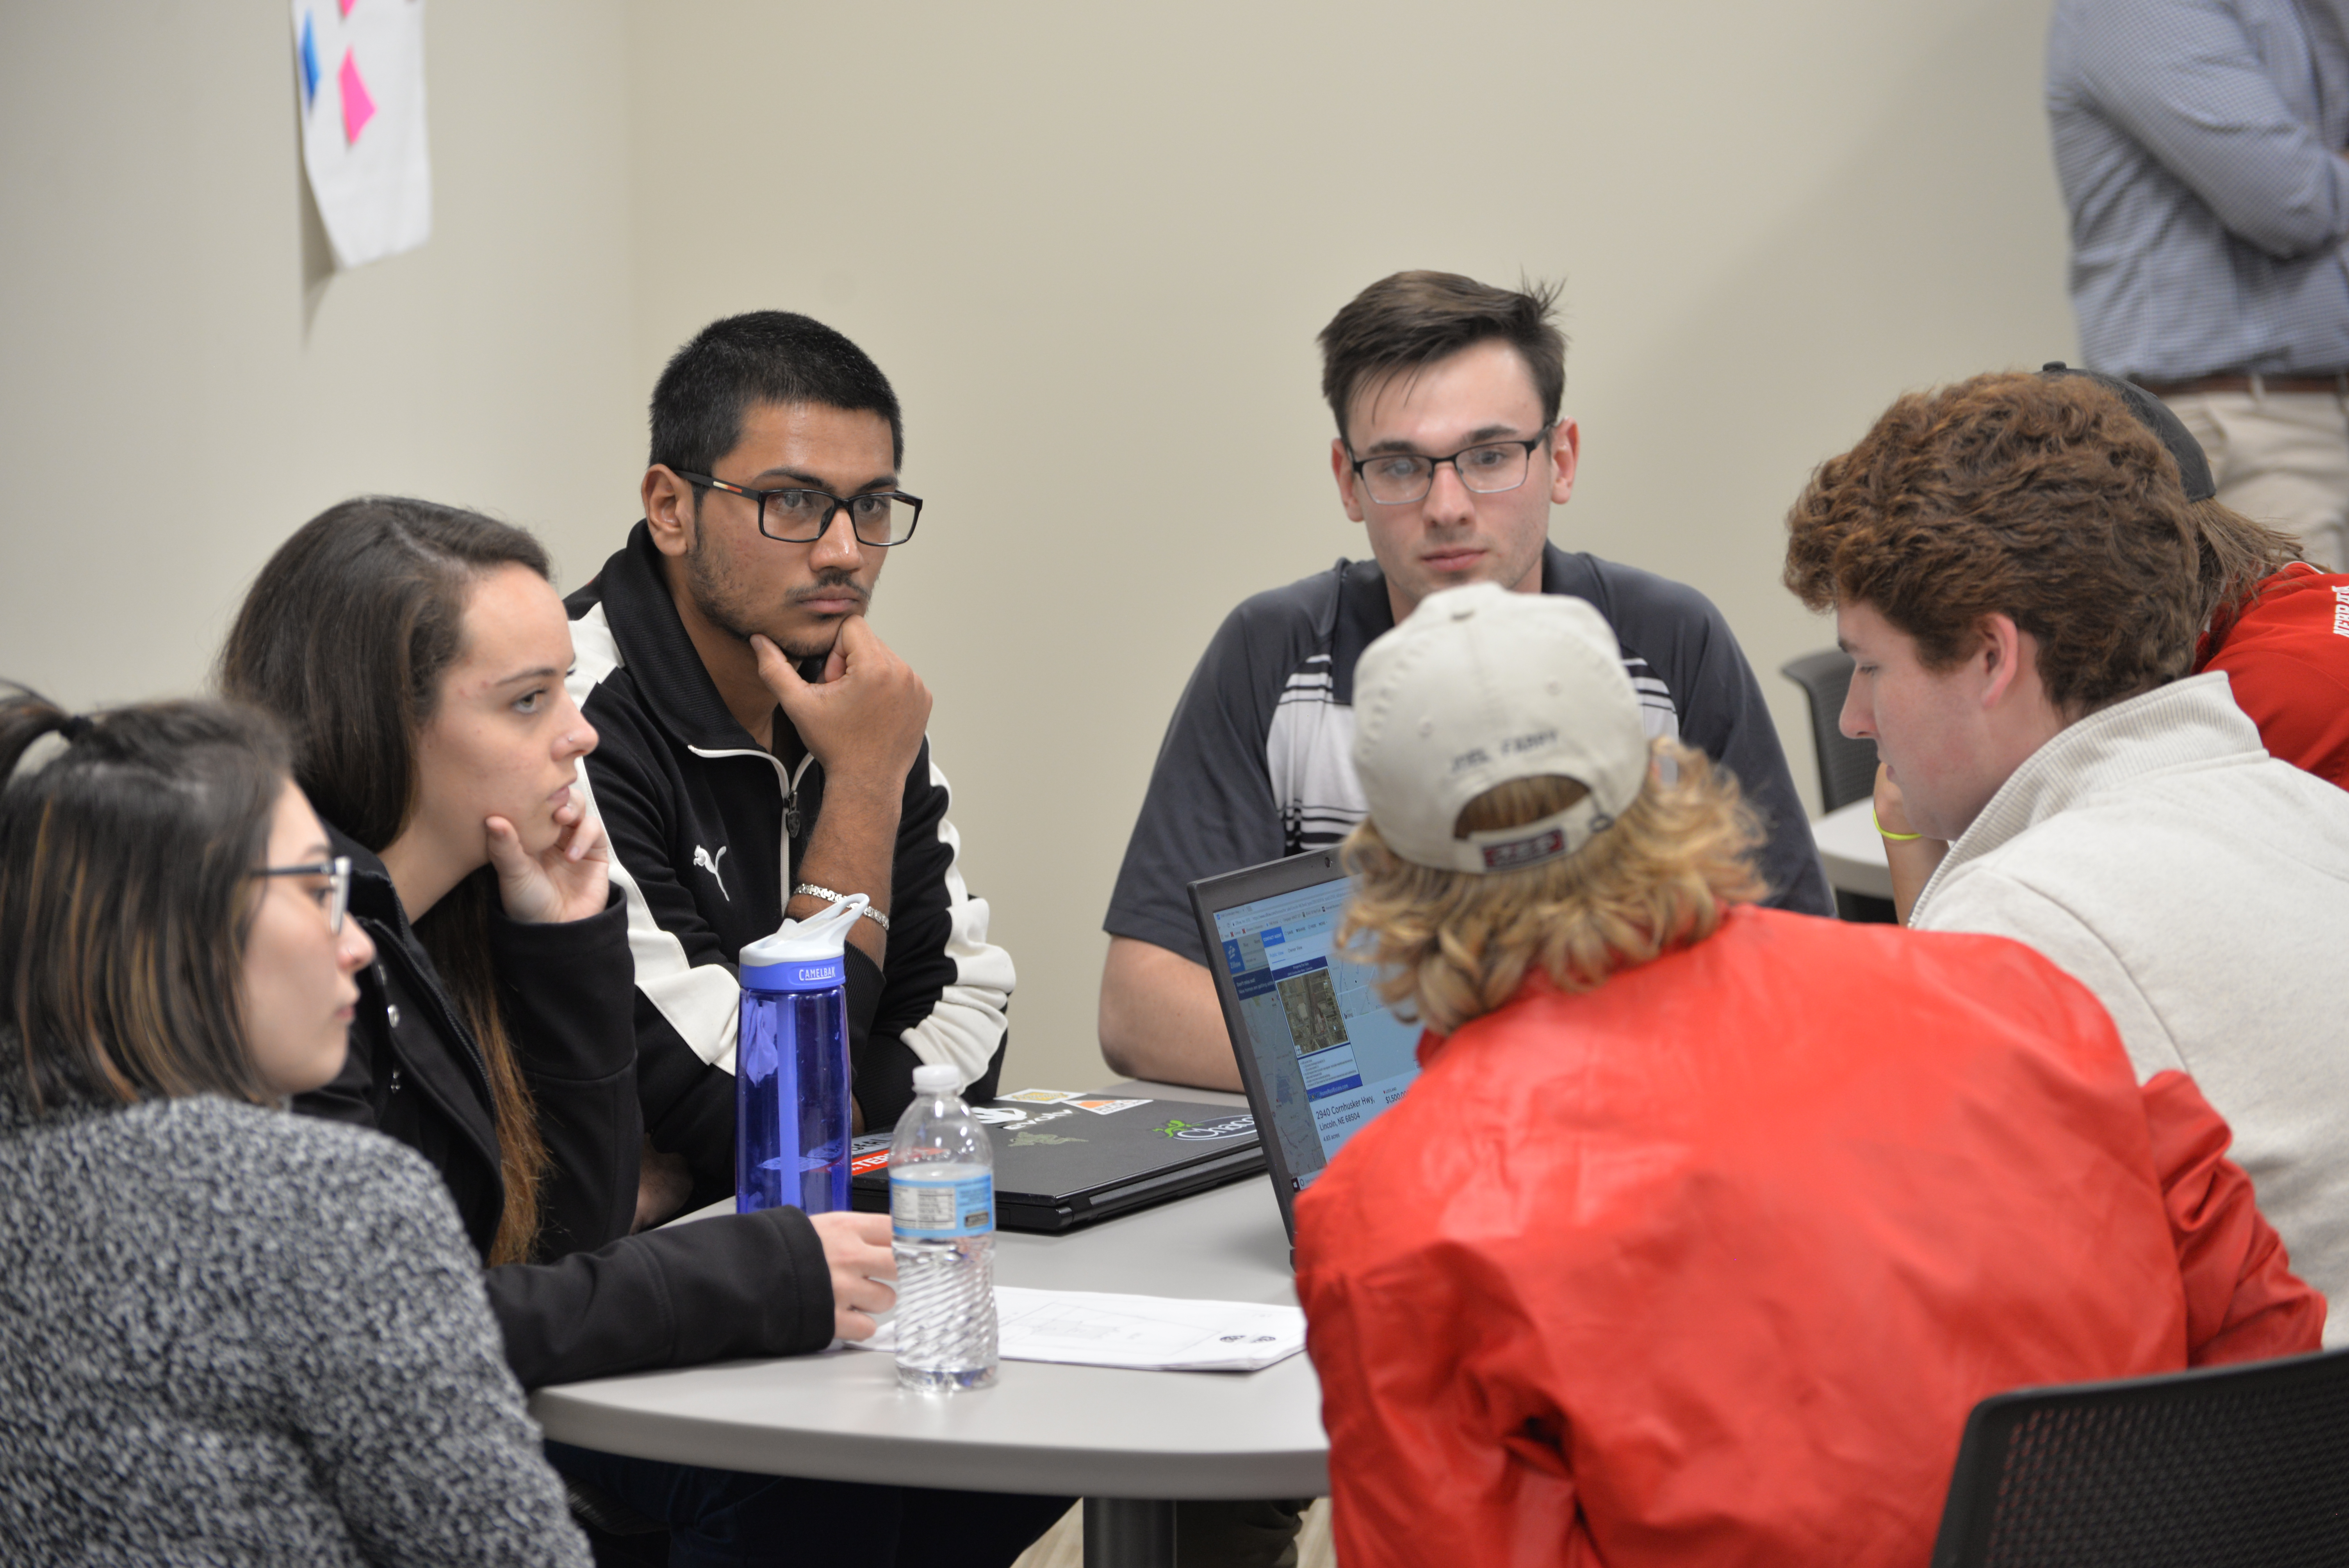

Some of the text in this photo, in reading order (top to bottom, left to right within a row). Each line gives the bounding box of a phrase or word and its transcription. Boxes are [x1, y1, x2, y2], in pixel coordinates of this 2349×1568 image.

[799, 967, 836, 981] CAMELBAK
[1308, 1092, 1321, 1103] HOME
[1316, 1096, 1375, 1119] 2940 Cornhusker Hwy,
[1002, 1109, 1073, 1130] evolv
[1319, 1112, 1360, 1131] Lincoln, NE 68504
